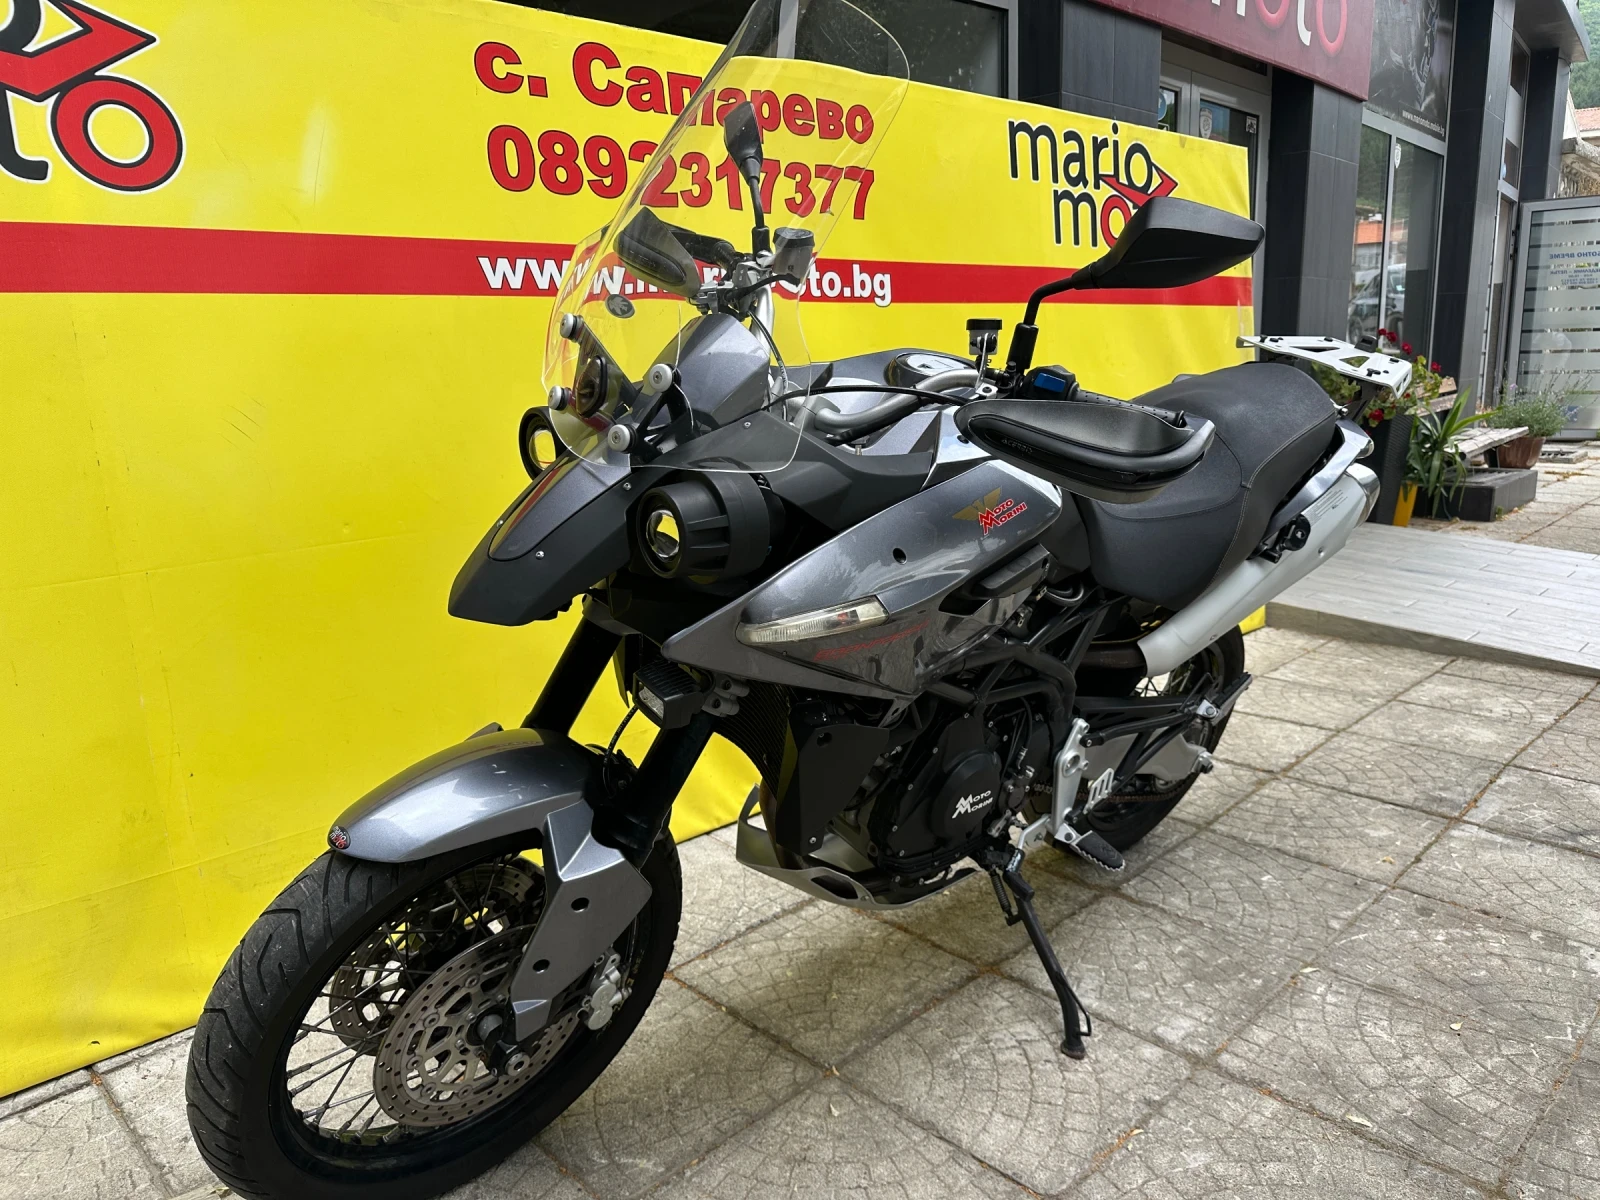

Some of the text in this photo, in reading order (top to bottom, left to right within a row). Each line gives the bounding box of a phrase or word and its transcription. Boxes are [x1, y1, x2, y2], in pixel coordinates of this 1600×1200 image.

[572, 41, 875, 145] Сапарево
[487, 124, 875, 220] 0892317377
[1008, 120, 1153, 195] mario
